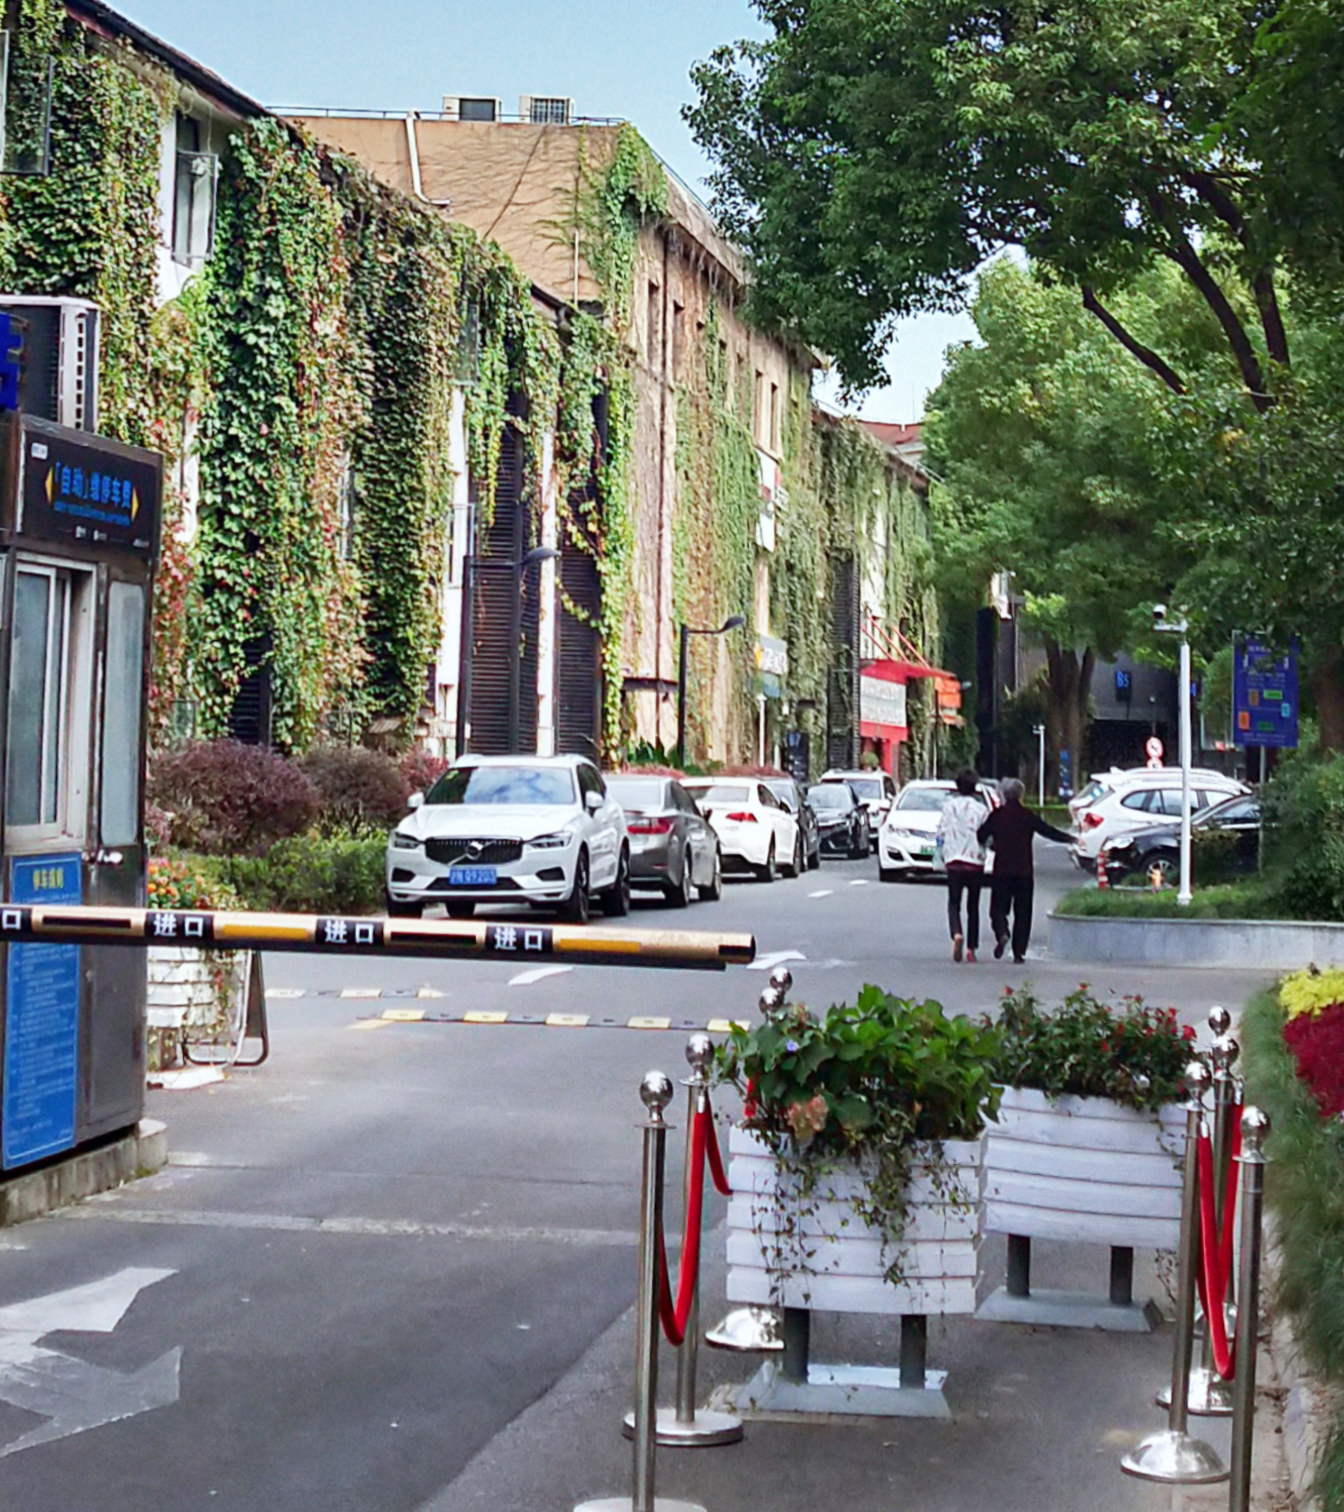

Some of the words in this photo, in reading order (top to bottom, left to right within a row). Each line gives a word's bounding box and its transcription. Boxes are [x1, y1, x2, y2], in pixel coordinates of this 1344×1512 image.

[154, 913, 204, 937] 进口
[324, 920, 374, 944] 进口
[494, 927, 543, 951] 进口
